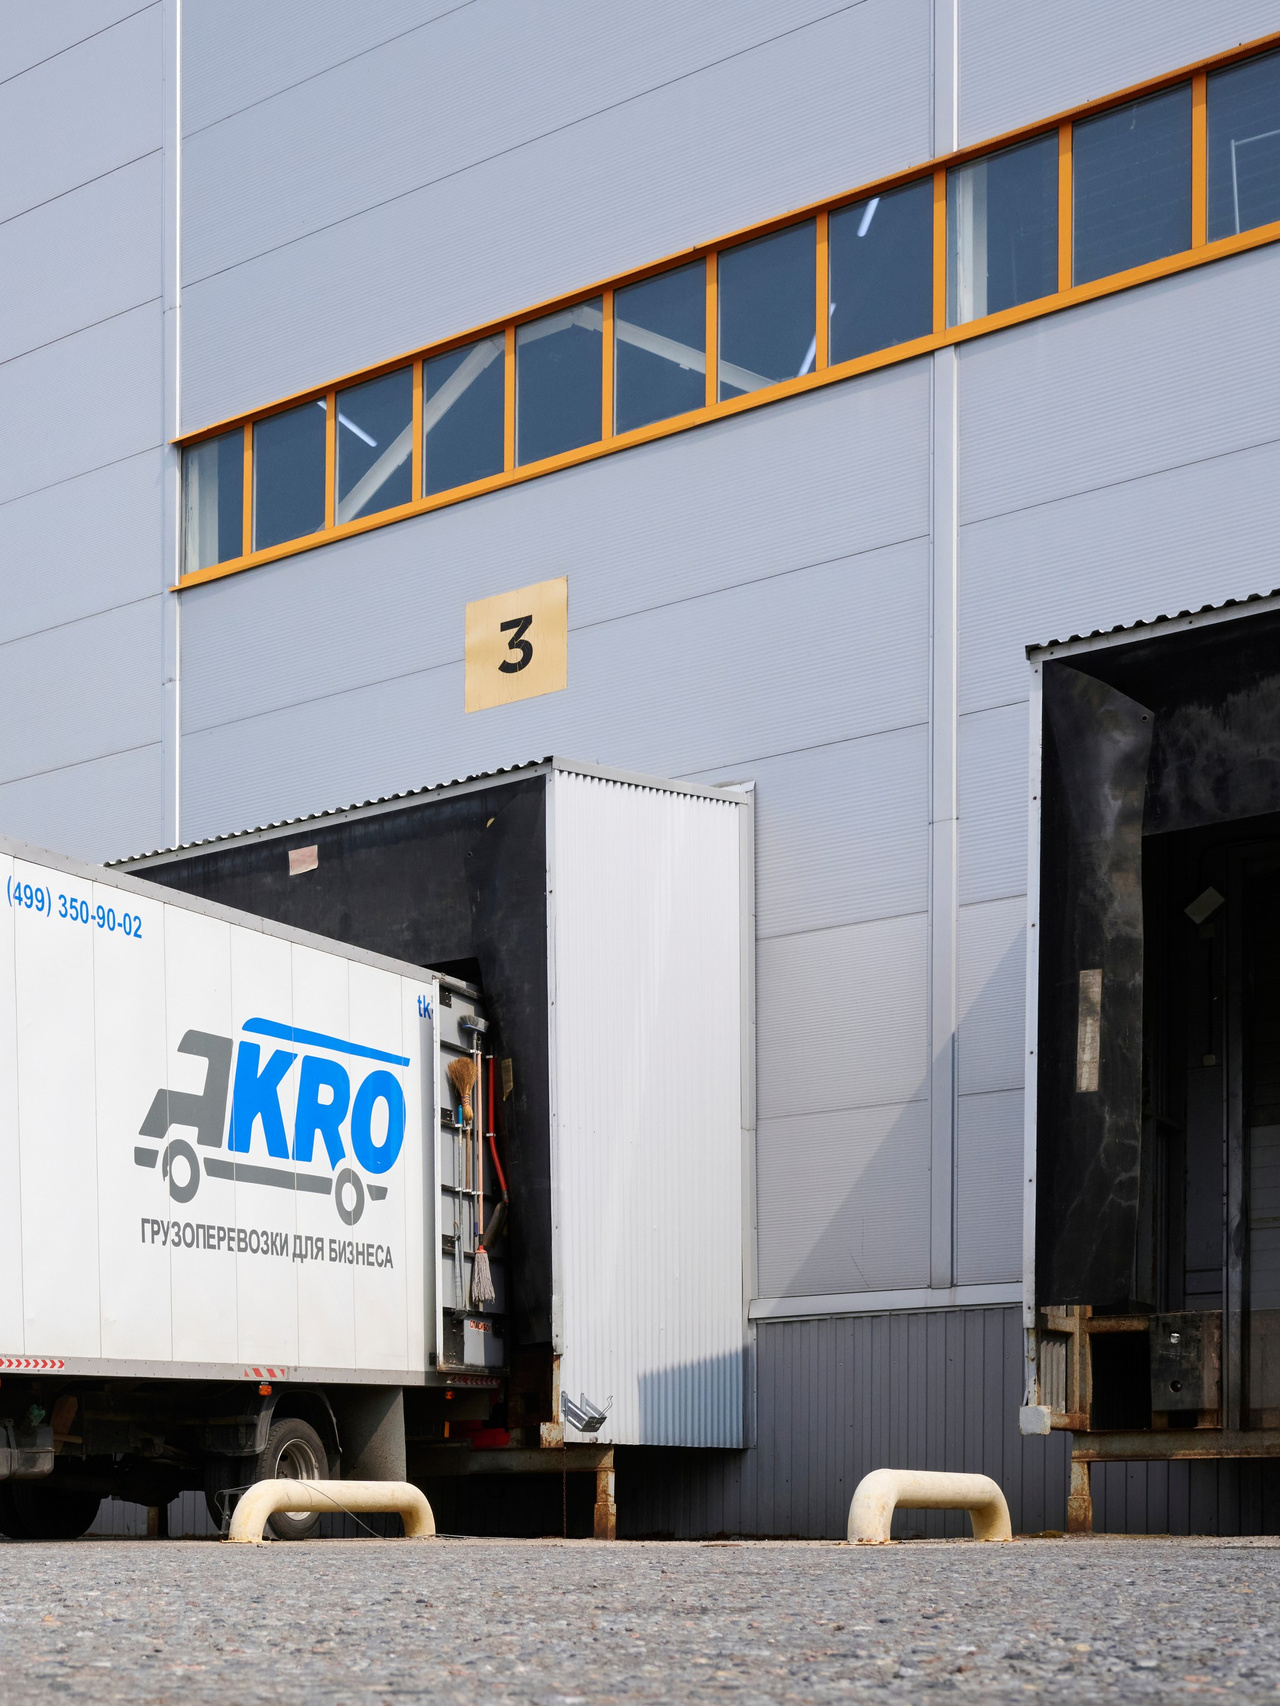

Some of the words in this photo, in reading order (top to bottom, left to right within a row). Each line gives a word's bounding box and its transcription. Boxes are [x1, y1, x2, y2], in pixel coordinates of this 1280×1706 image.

[498, 614, 533, 674] 3
[7, 875, 52, 918] (499)
[58, 894, 143, 939] 350-90-02
[141, 1218, 289, 1257] ГРУЗОПЕРЕВОЗКИ
[292, 1234, 325, 1264] ДЛЯ
[328, 1239, 394, 1269] БИЗНЕСА
